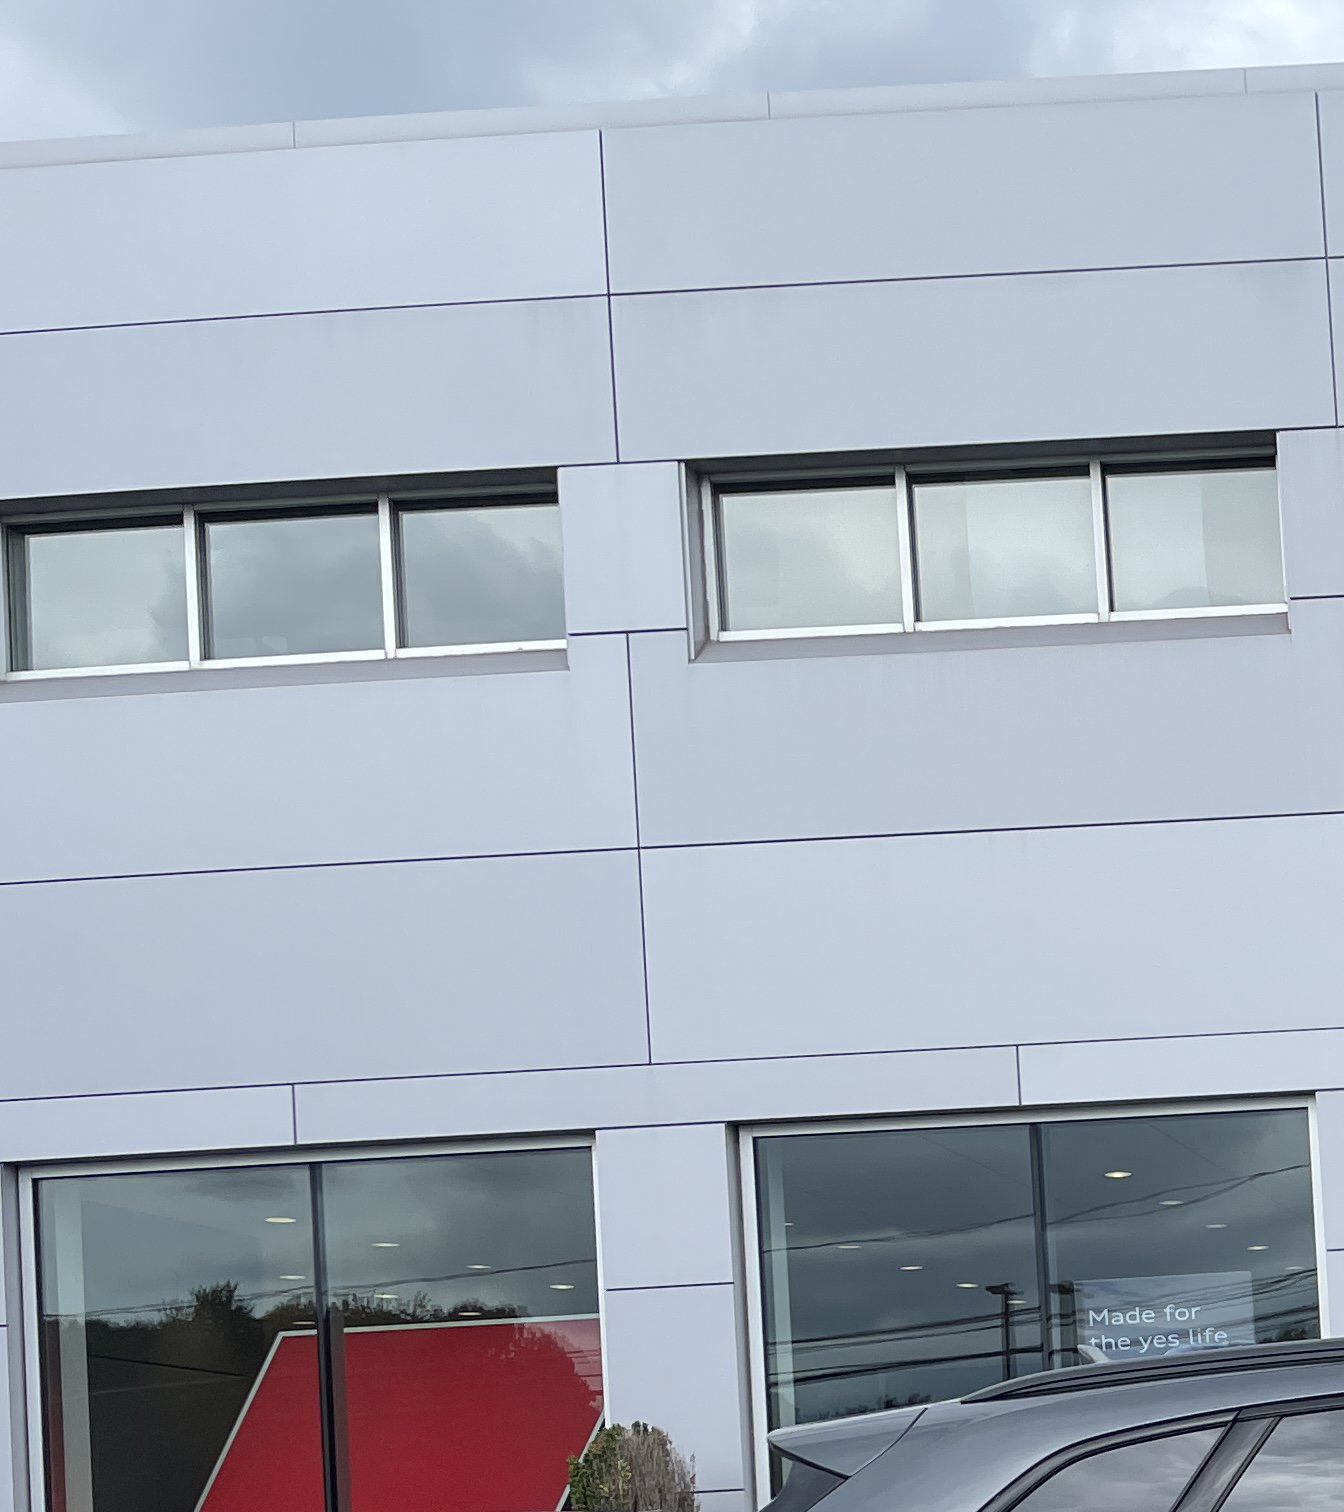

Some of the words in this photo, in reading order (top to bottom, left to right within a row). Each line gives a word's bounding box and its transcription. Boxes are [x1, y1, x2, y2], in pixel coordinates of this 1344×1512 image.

[1088, 1306, 1156, 1327] Made
[1164, 1303, 1201, 1322] for
[1088, 1334, 1132, 1352] the
[1139, 1333, 1181, 1354] yes
[1188, 1327, 1229, 1346] life
